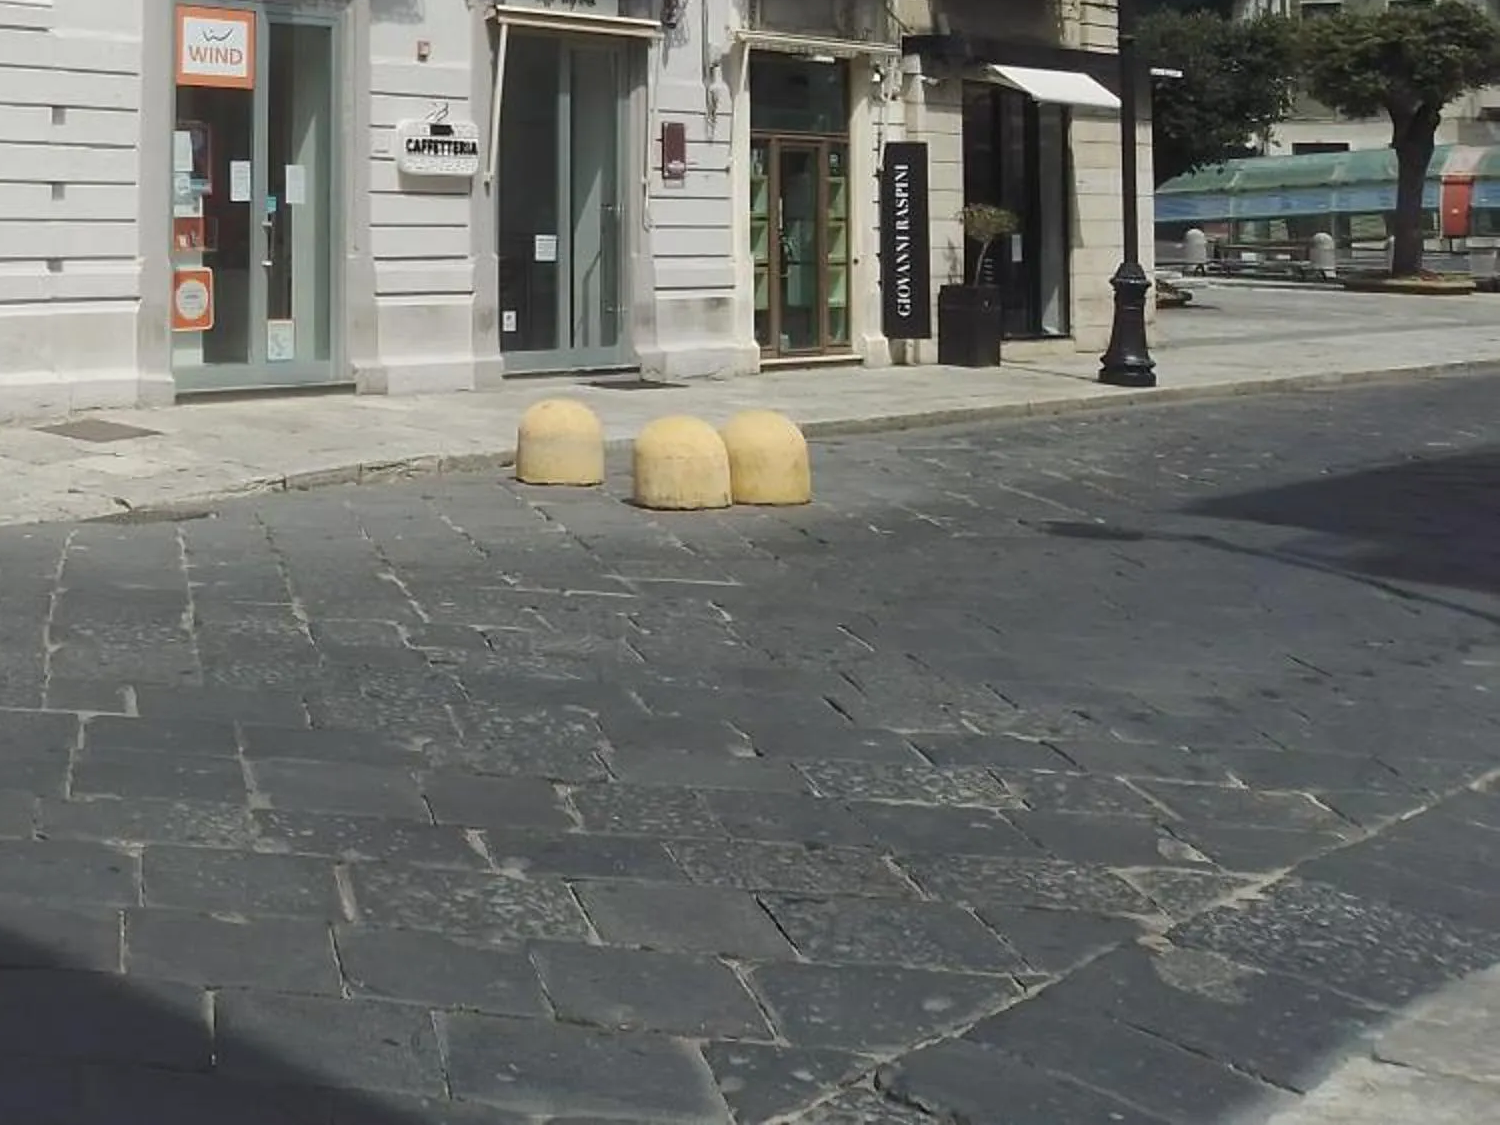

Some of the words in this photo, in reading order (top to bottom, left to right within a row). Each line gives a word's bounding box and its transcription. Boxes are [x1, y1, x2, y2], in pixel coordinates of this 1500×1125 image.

[188, 45, 243, 65] WIND
[405, 138, 478, 156] CAFFETTERIA
[894, 164, 910, 230] RASPINI
[895, 236, 912, 317] GIOVANNI
